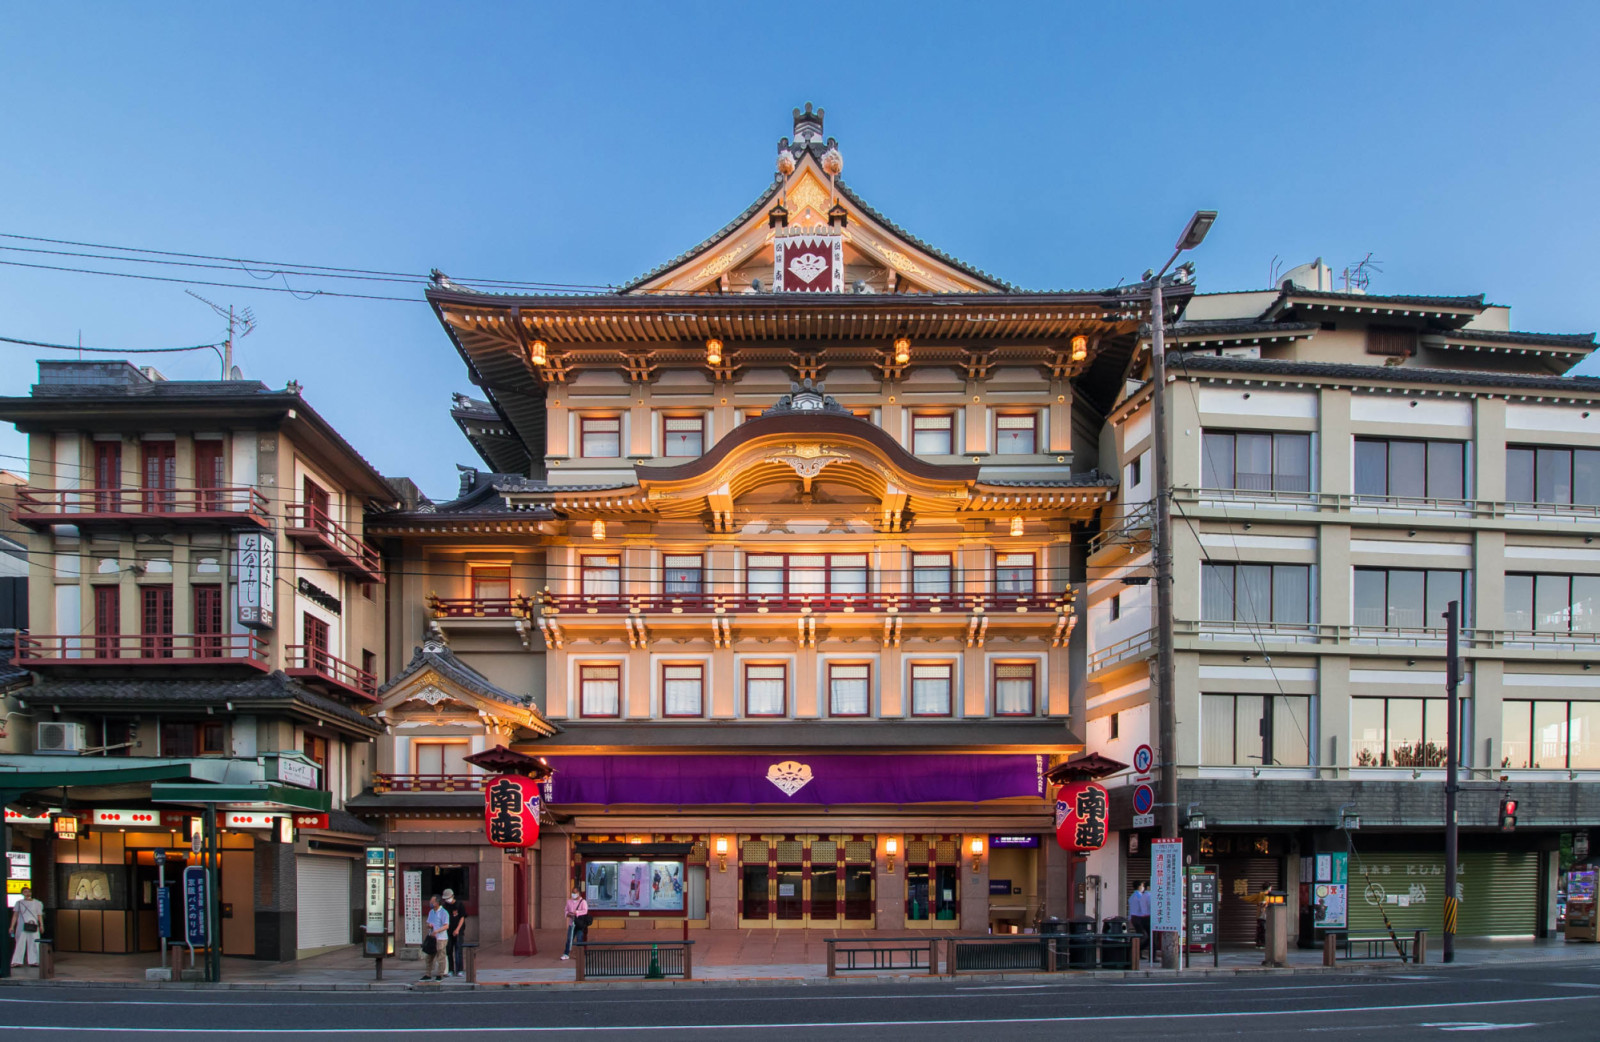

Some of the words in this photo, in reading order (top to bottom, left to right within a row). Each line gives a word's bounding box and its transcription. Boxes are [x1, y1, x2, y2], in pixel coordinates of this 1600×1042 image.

[241, 607, 258, 620] 3F
[261, 609, 273, 624] 3F
[490, 779, 523, 844] 南座
[1075, 786, 1106, 847] 南座
[1156, 853, 1164, 923] 通行禁止となります
[1407, 864, 1465, 875] にしんば
[187, 878, 198, 937] 京阪バスのりば
